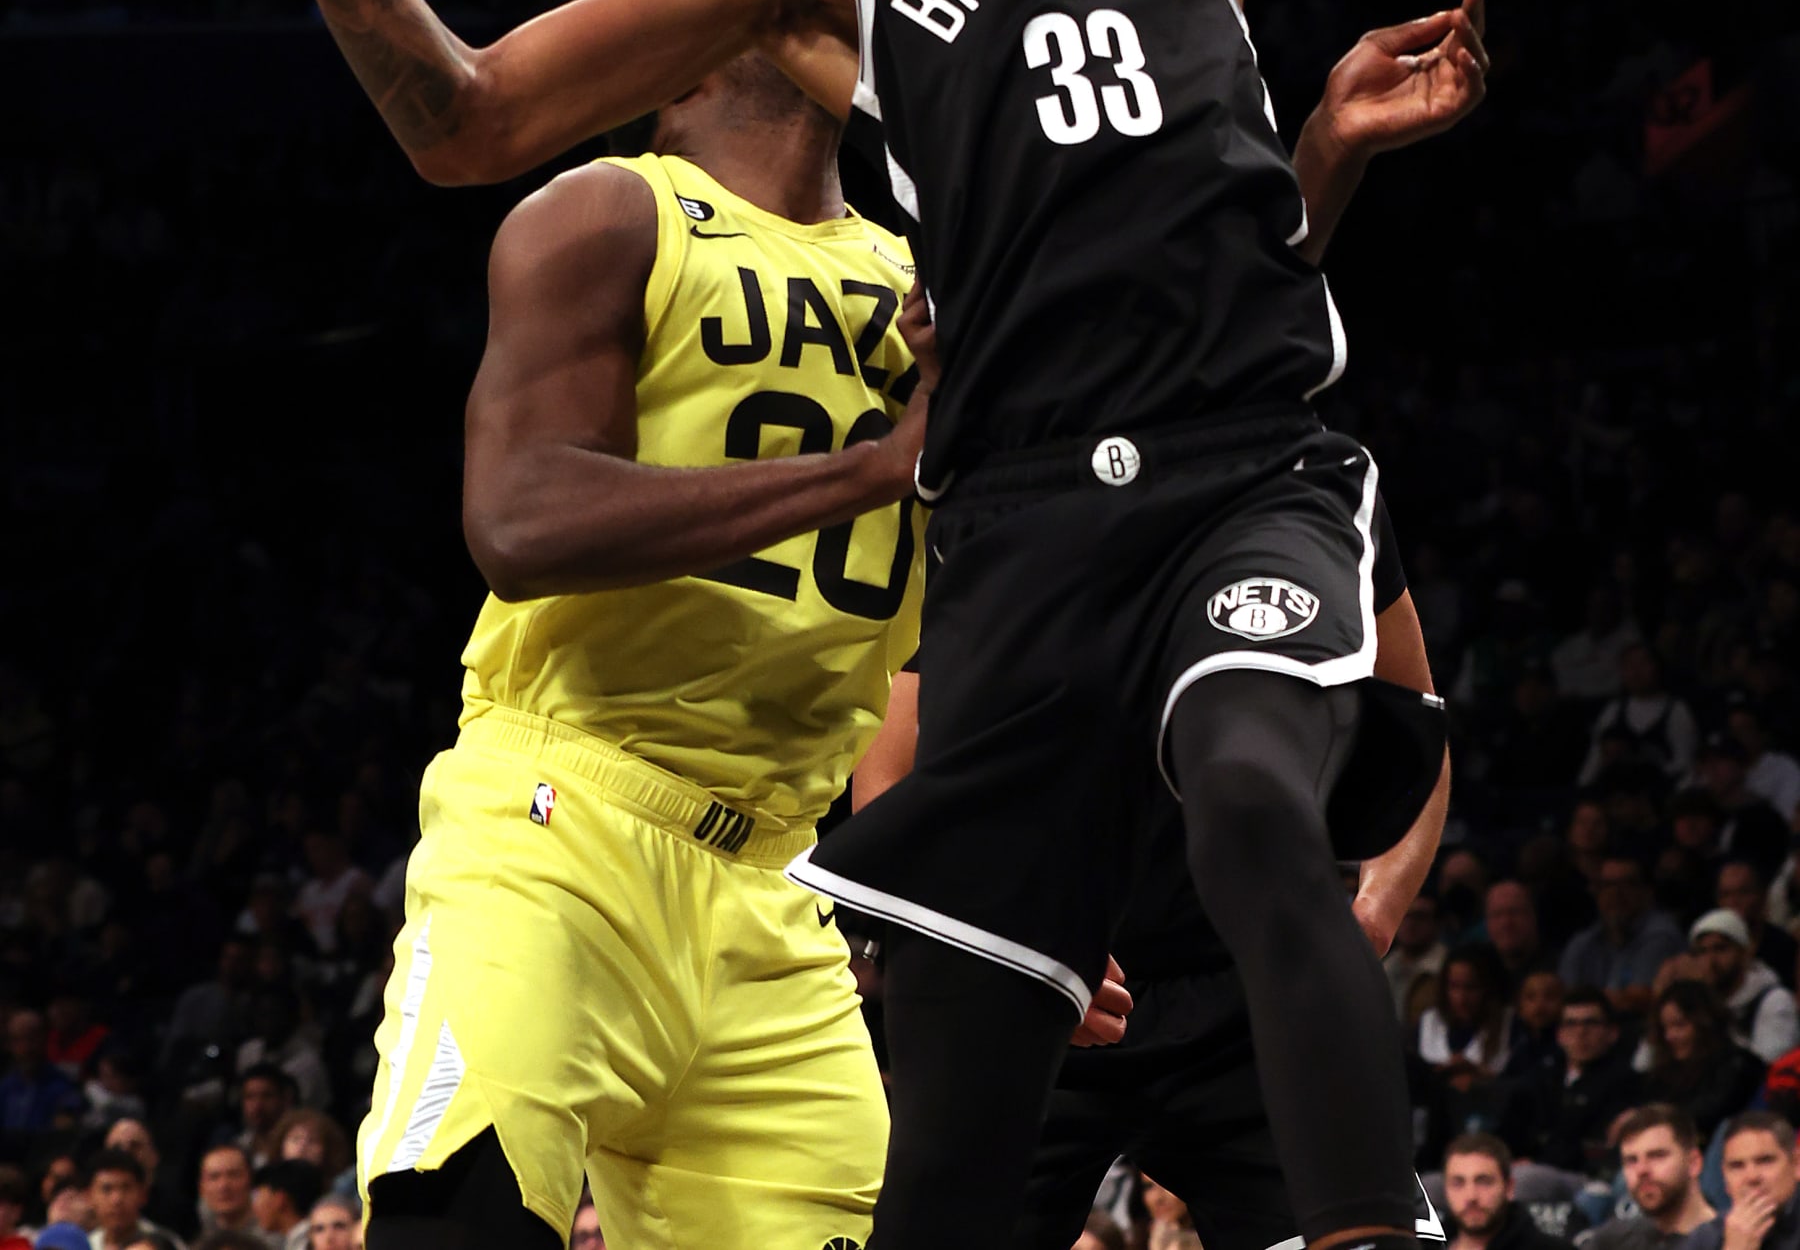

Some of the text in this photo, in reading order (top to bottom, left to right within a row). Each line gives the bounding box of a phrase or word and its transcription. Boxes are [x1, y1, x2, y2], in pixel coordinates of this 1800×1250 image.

[1022, 8, 1164, 145] 33
[1108, 445, 1125, 478] B
[689, 391, 914, 621] 20
[1212, 581, 1312, 619] NETS
[693, 800, 755, 854] UTAH
